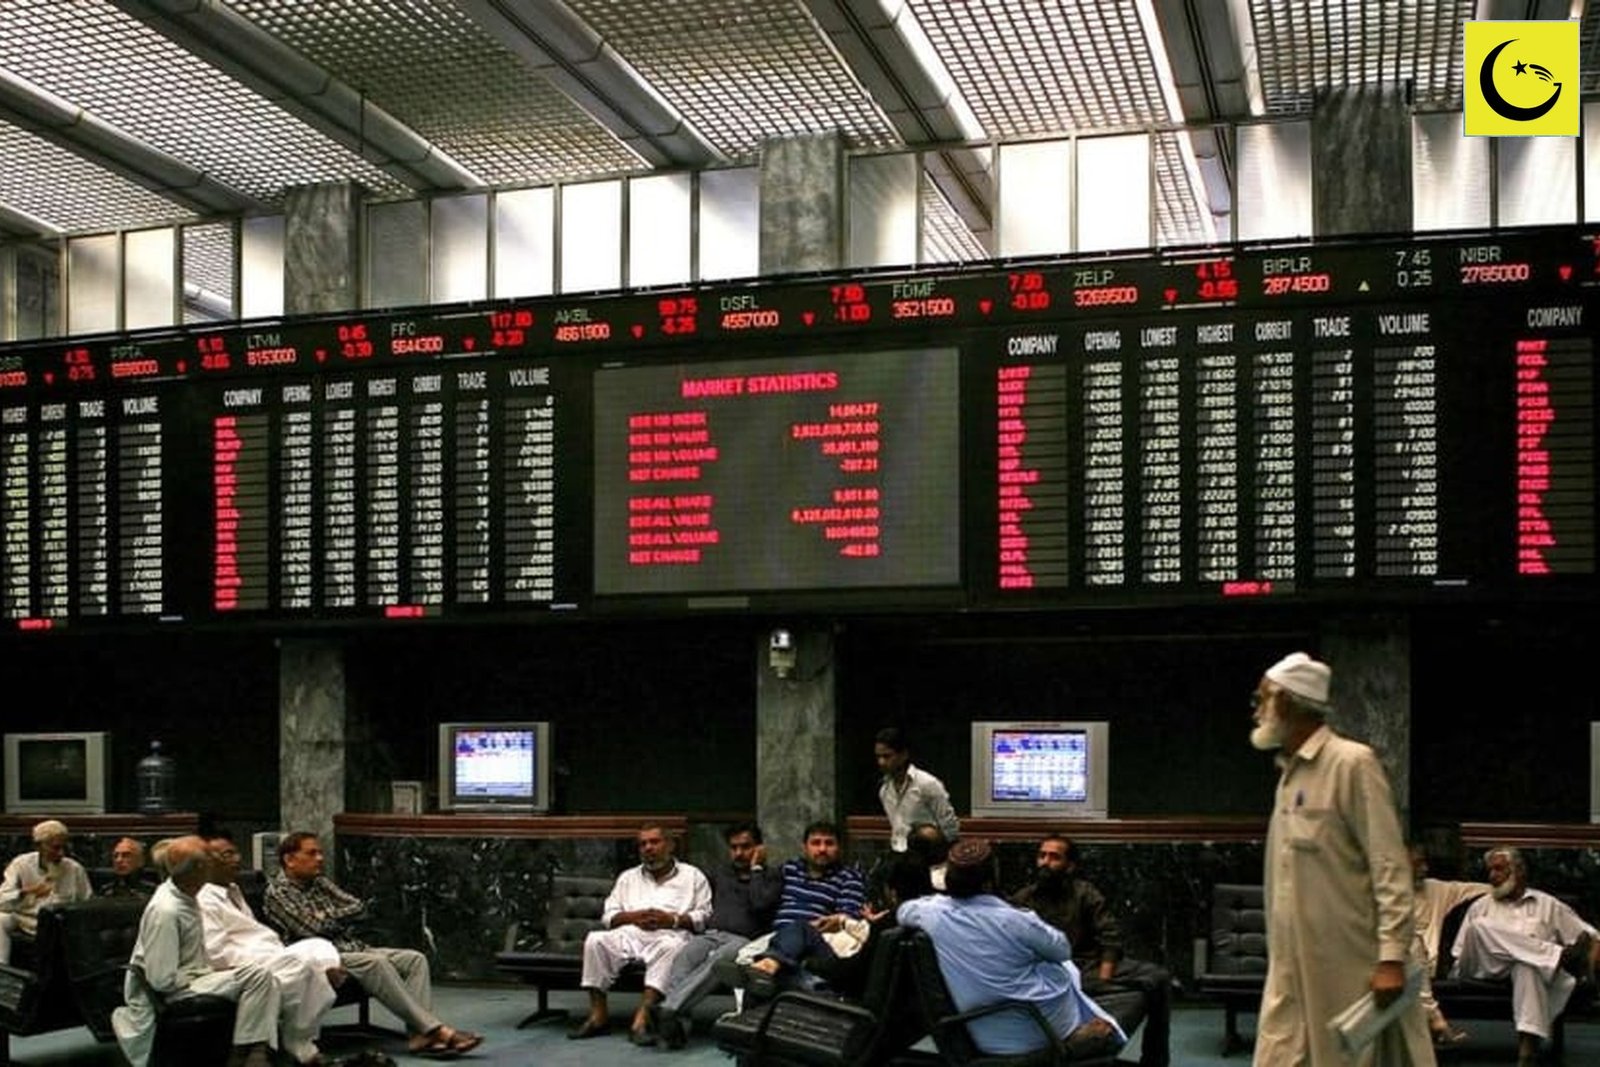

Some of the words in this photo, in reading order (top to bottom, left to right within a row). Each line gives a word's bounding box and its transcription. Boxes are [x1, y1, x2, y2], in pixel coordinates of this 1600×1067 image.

[1263, 257, 1311, 274] BIPLR
[1396, 250, 1432, 268] 7.45
[1074, 270, 1114, 287] ZELP
[1398, 270, 1433, 287] 0.25
[720, 297, 760, 312] DSFL
[1527, 306, 1583, 328] COMPANY
[391, 322, 416, 338] FFC
[1008, 334, 1059, 356] COMPANY
[1085, 331, 1121, 351] OPENING
[1140, 326, 1178, 348] LOWEST
[1197, 324, 1235, 345] HIGHEST
[1254, 321, 1293, 341] CURRENT
[1313, 316, 1351, 338] TRADE
[1378, 314, 1431, 335] VOLUME
[457, 371, 488, 390] TRADE
[508, 367, 550, 387] VOLUME
[681, 378, 744, 398] MARKET
[747, 372, 838, 394] STATISTICS
[122, 397, 159, 416] VOLUME
